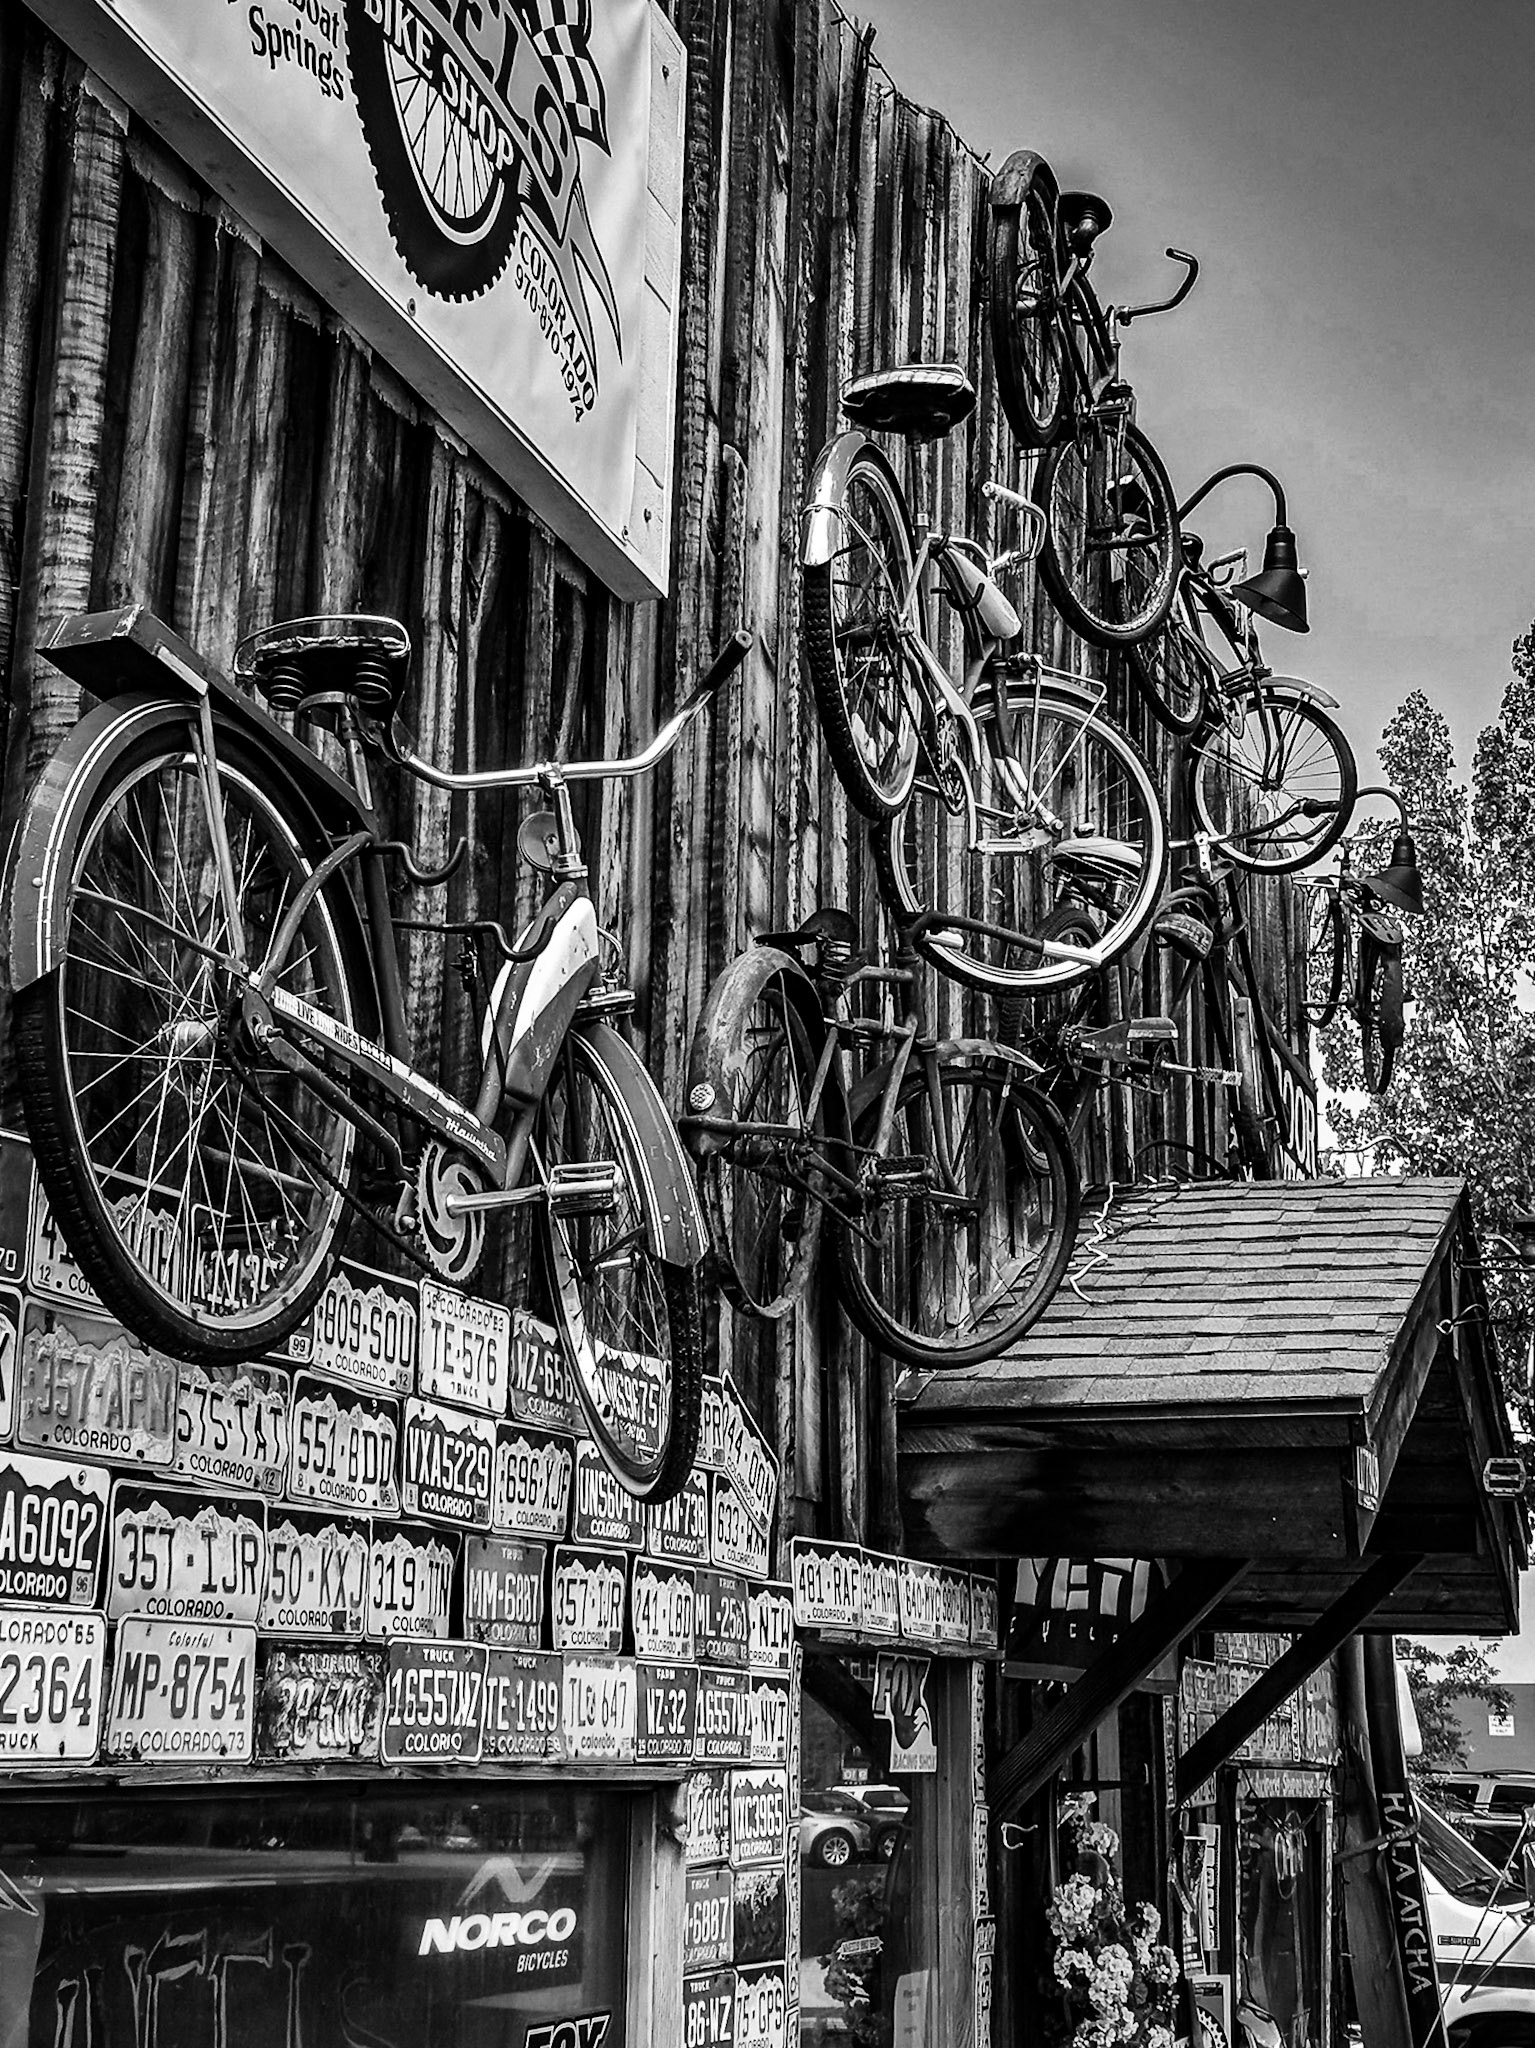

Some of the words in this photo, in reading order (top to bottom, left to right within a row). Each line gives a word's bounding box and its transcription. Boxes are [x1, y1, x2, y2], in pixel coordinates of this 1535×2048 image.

[249, 5, 344, 101] Springs
[442, 52, 514, 171] SHOP
[520, 231, 595, 411] COLORADO
[514, 264, 585, 423] 970-870-1974
[439, 1296, 490, 1327] COLORADO
[335, 1354, 386, 1381] COLORADO
[432, 1318, 497, 1386] TE-576
[54, 1424, 131, 1452] COLORADO
[299, 1411, 392, 1487] 551-BDD
[190, 1454, 253, 1483] COLORADO
[264, 1470, 275, 1486] 12
[409, 1427, 490, 1498] VXA5229
[319, 1479, 367, 1503] COLORADO
[422, 1491, 472, 1519] COLORADO
[0, 1490, 98, 1571] A6092
[516, 1511, 552, 1528] COLORADO
[590, 1519, 630, 1540] COLORADO
[800, 1563, 859, 1607] 481-RAF
[147, 1598, 225, 1618] COLORADO
[169, 1630, 215, 1648] Colorful
[423, 1649, 455, 1663] TRUCK
[0, 1654, 92, 1726] 2364
[116, 1652, 246, 1720] MP-8754
[486, 1676, 559, 1731] TE-1499
[646, 1688, 687, 1735] WZ-32
[140, 1731, 222, 1752] COLORADO
[228, 1732, 245, 1751] 73
[418, 1907, 577, 1956] NORCO
[516, 1950, 569, 1973] BICYCLES
